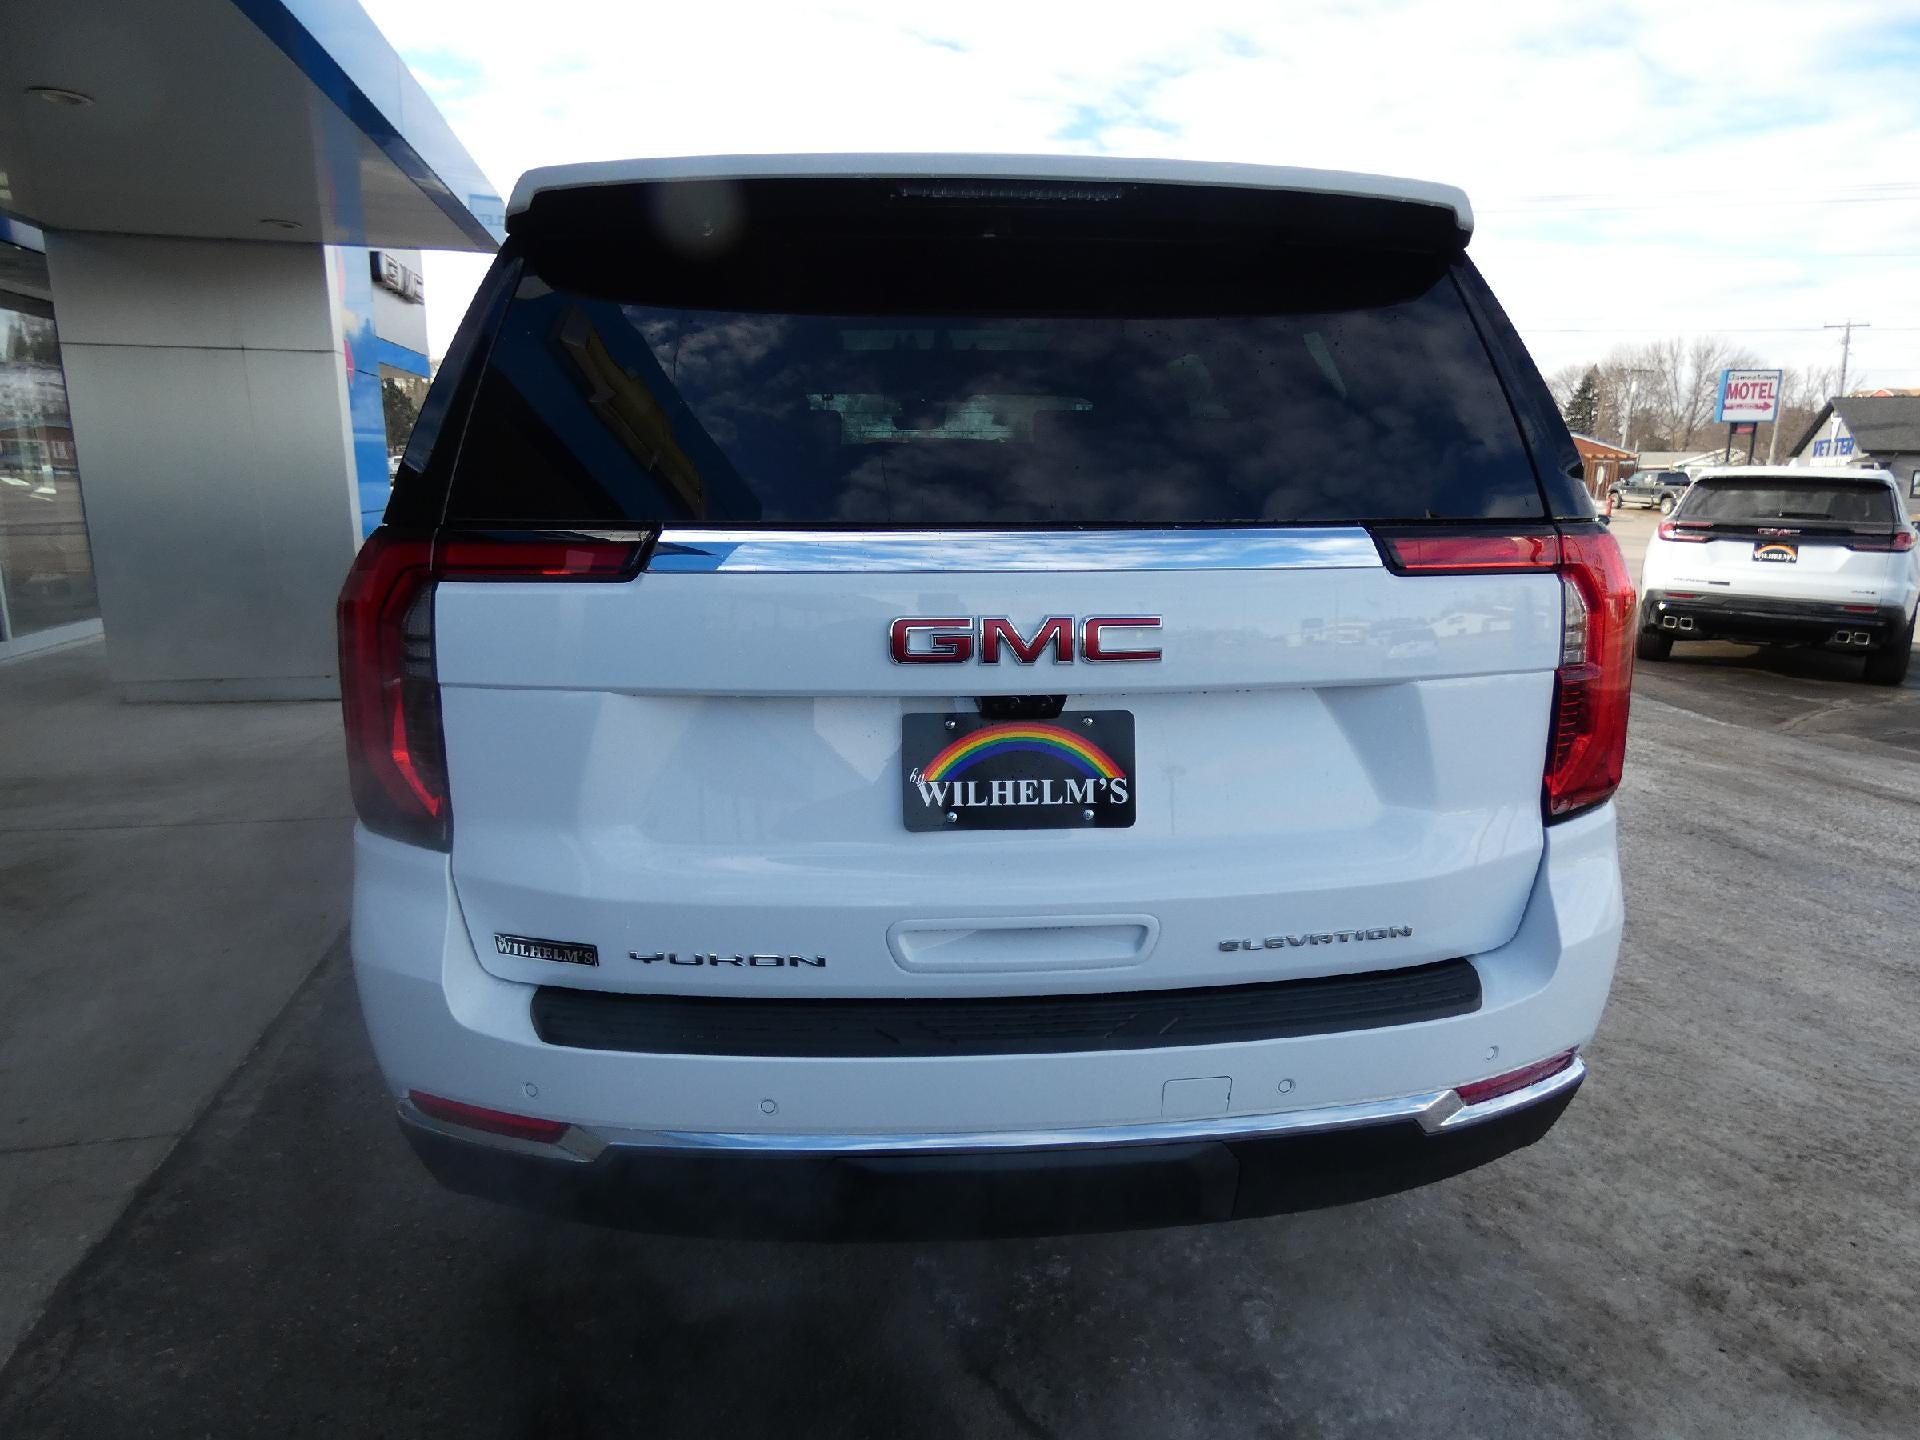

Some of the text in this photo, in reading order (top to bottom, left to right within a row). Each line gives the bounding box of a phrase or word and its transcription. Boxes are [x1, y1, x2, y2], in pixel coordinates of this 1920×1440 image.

[1725, 382, 1775, 400] MOTEL
[888, 614, 1163, 666] GMC
[909, 767, 927, 787] by
[918, 777, 1130, 808] WILHELM'S
[1218, 925, 1414, 952] ELEVATION
[498, 940, 594, 965] WILHELM'S
[629, 950, 826, 968] YUKON
